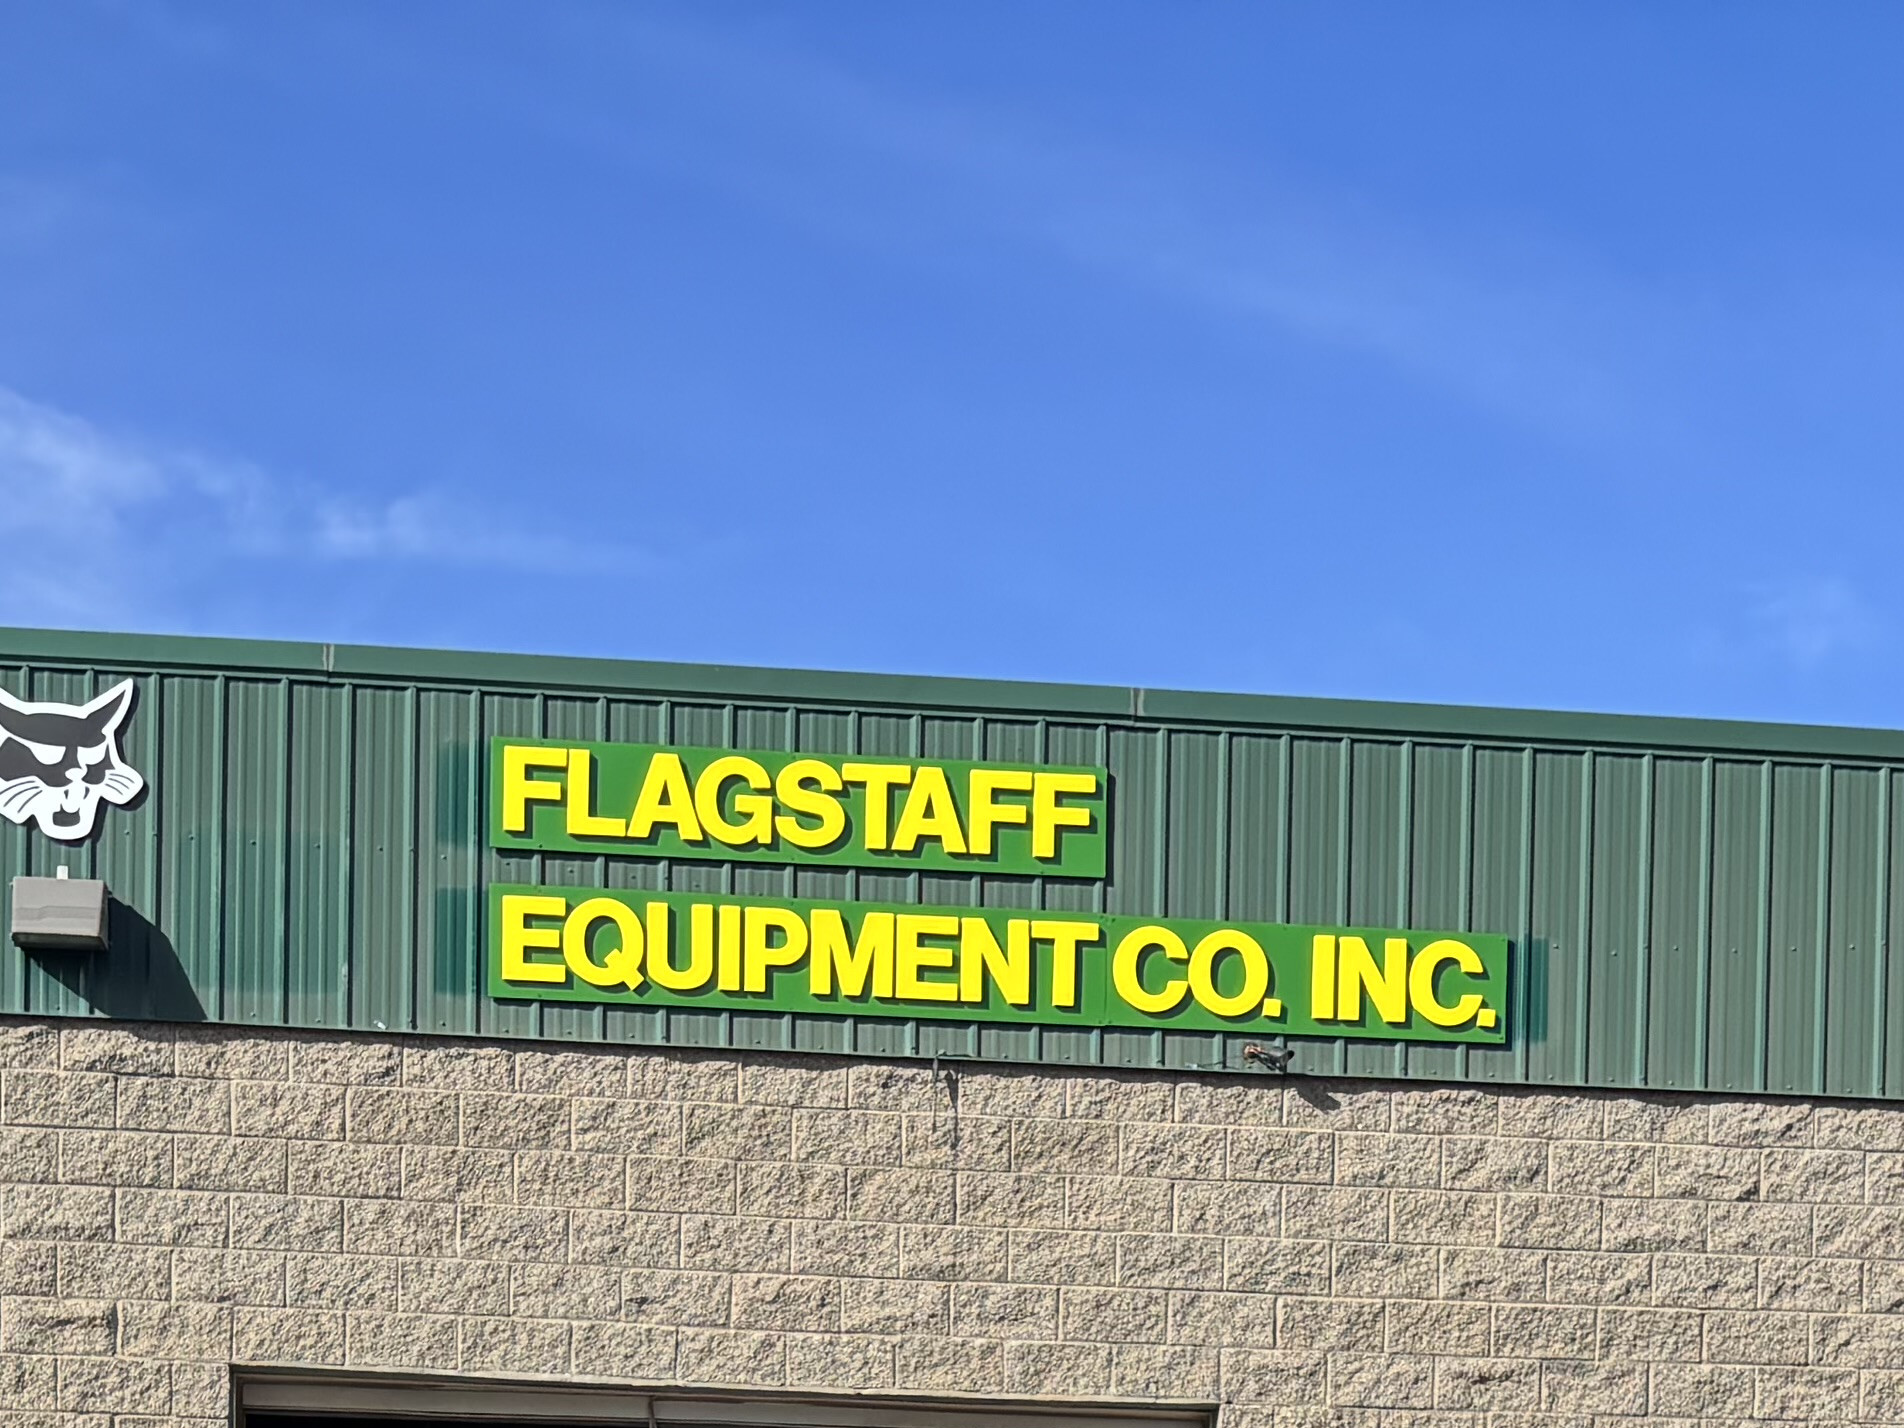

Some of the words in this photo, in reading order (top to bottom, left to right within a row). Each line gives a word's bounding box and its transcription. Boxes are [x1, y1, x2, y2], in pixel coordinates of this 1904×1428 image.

[501, 745, 1097, 859] FLAGSTAFF
[500, 895, 1100, 1008] EQUIPMENT
[1111, 924, 1283, 1018] CO.
[1310, 934, 1497, 1029] INC.
